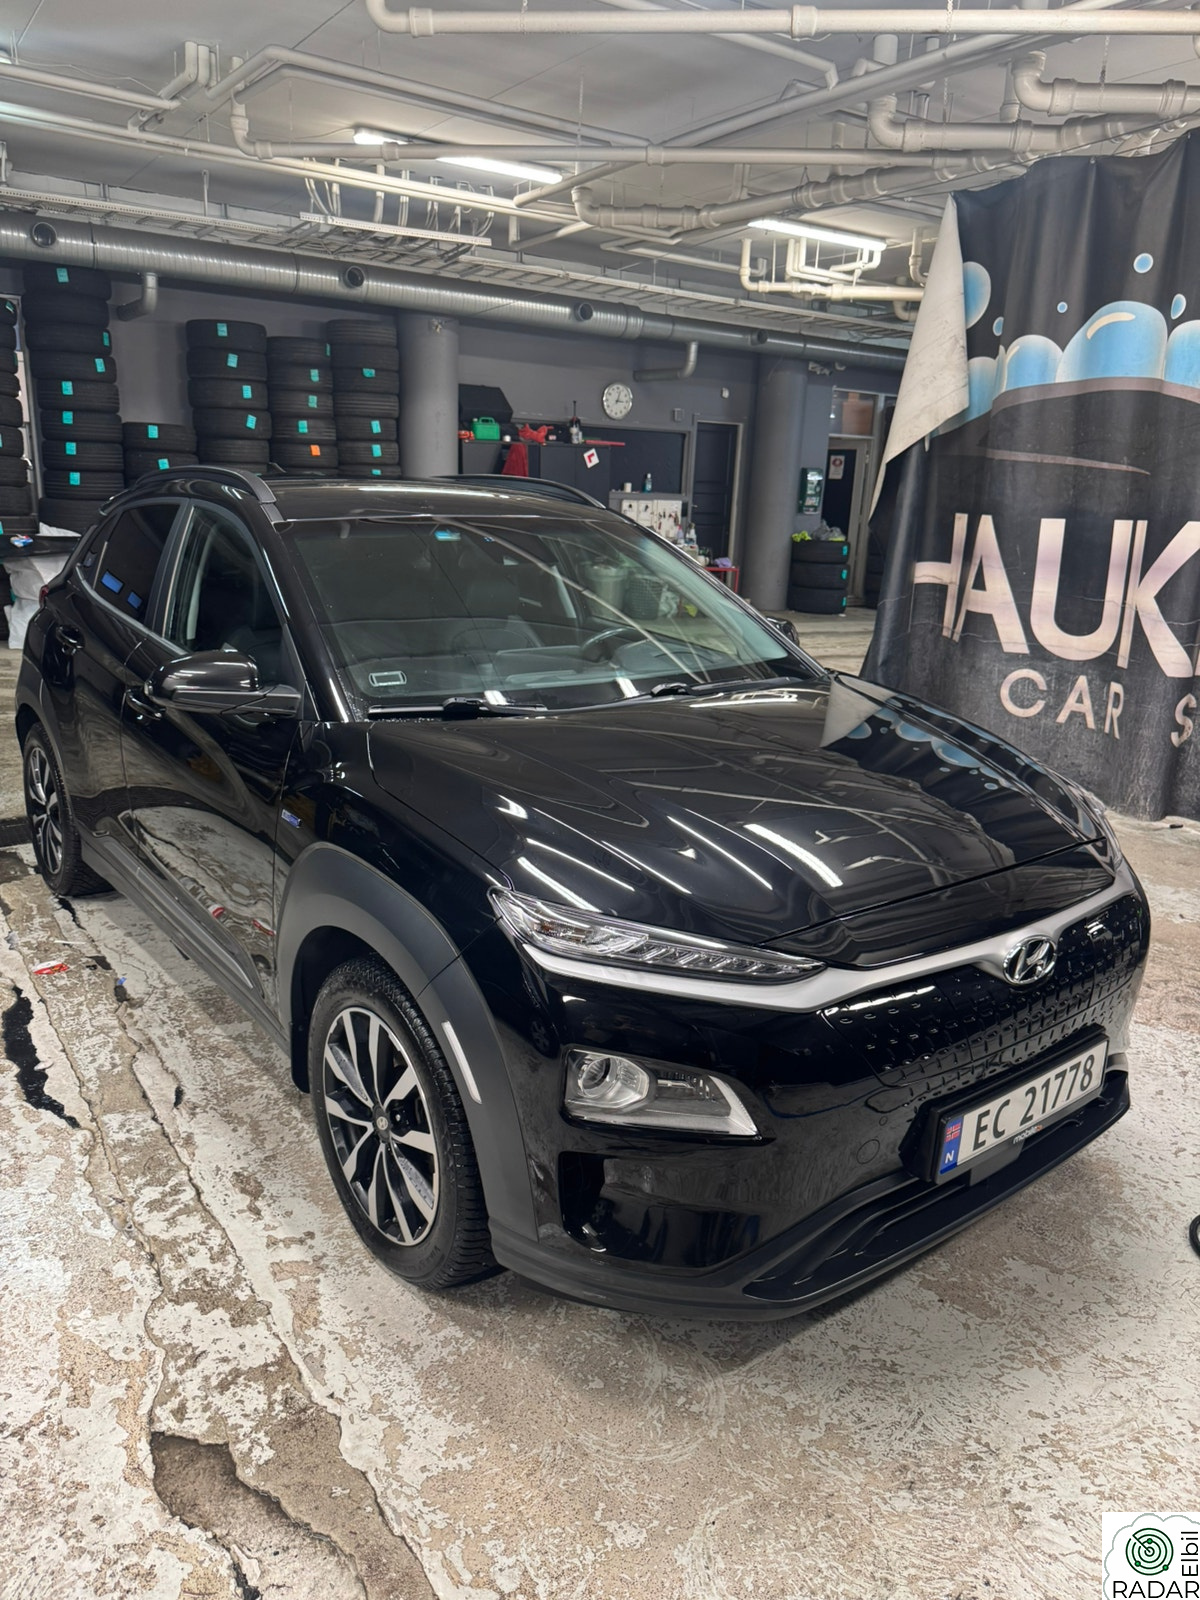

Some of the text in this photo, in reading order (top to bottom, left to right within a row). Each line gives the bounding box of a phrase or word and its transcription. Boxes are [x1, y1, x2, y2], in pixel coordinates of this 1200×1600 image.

[913, 512, 1200, 678] HAUK
[999, 667, 1125, 740] CAR
[972, 1054, 1095, 1152] EC 21778
[944, 1150, 955, 1164] N
